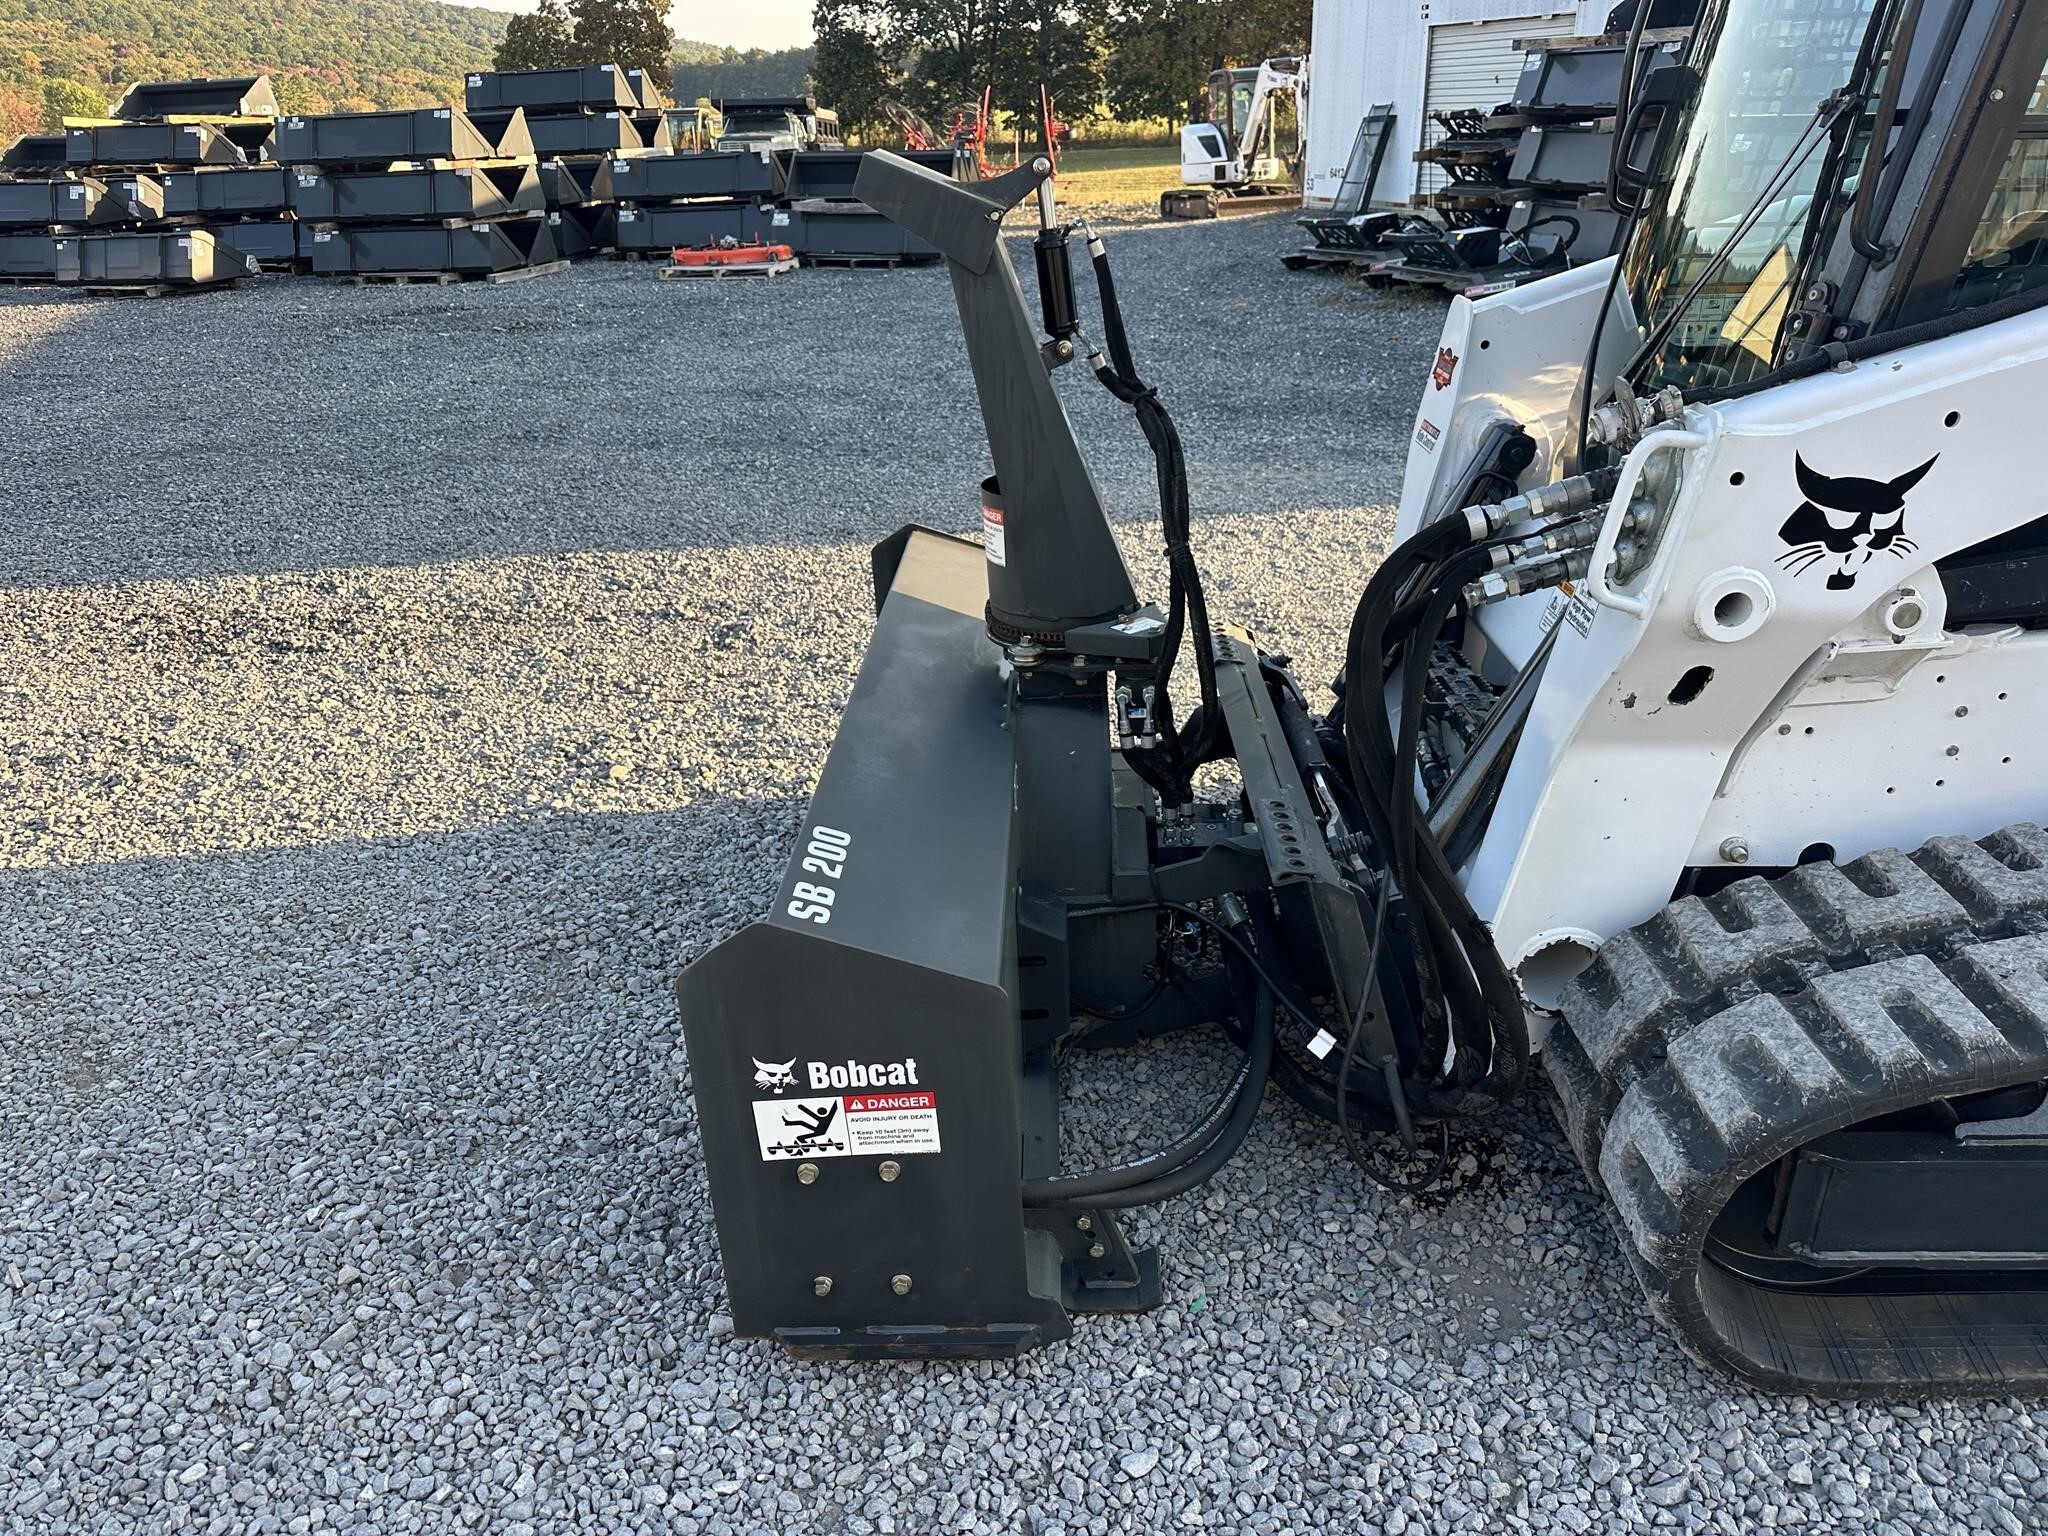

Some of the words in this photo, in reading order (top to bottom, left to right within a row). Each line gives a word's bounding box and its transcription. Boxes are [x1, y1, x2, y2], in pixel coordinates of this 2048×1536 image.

[1568, 610, 1588, 633] Hydraulics
[1571, 600, 1582, 614] High
[1580, 609, 1591, 624] Flow
[802, 825, 851, 879] 200
[787, 881, 836, 924] SB
[807, 1057, 919, 1090] Bobcat
[867, 1096, 929, 1109] DANGER
